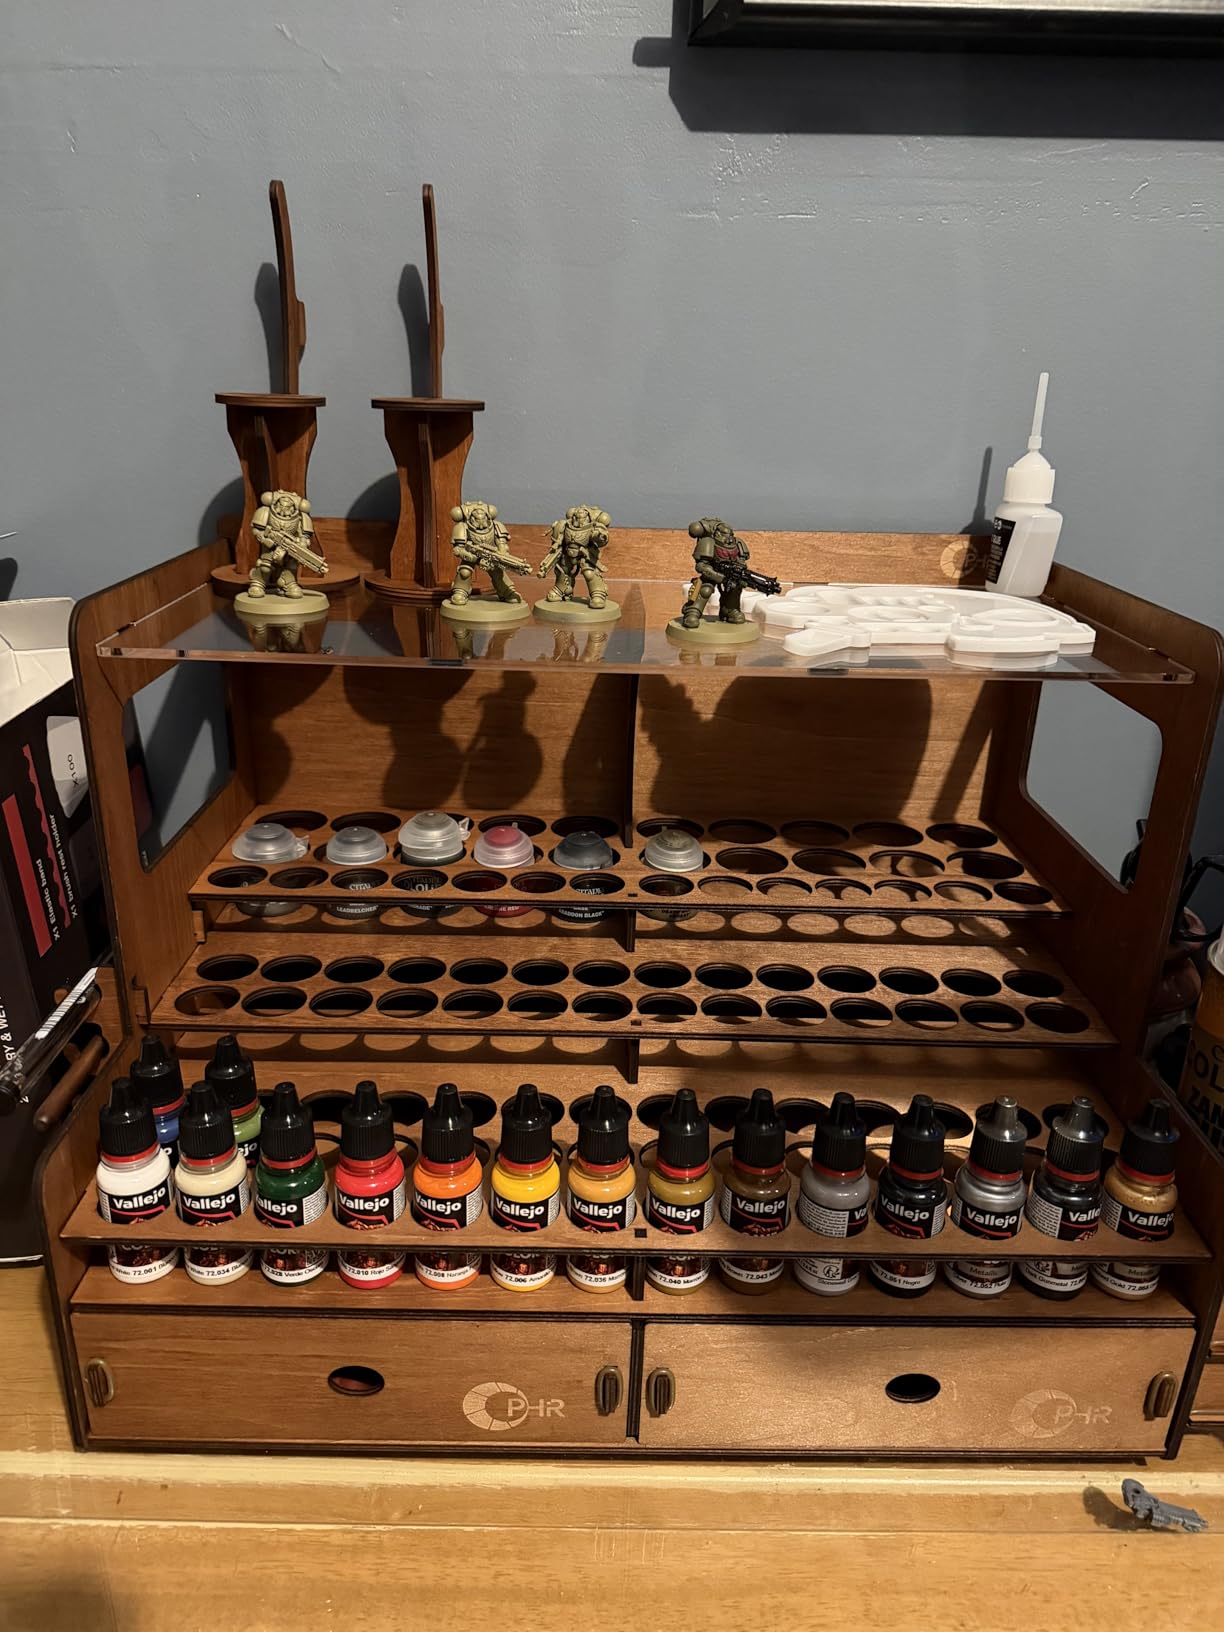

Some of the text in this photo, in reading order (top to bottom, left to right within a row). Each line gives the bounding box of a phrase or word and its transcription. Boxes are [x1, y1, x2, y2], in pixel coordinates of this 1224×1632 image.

[49, 814, 63, 848] holder
[57, 849, 68, 871] rest
[35, 858, 47, 888] band
[62, 872, 75, 902] brush
[44, 888, 58, 924] Elastic
[0, 1032, 12, 1042] &
[113, 1187, 166, 1210] Vallejo
[183, 1193, 236, 1210] Vallejo
[256, 1196, 298, 1216] allejo
[339, 1194, 390, 1212] Vallejo
[415, 1191, 462, 1215] Vallejo
[495, 1197, 545, 1219] Vallejo
[573, 1197, 623, 1219] Vallejo
[652, 1197, 701, 1222] Vallejo
[736, 1197, 786, 1215] Vallejo
[881, 1194, 930, 1222] Vallejo
[966, 1207, 1018, 1229] Vallejo
[1069, 1207, 1100, 1222] Valle
[1127, 1211, 1174, 1227] Vallejo
